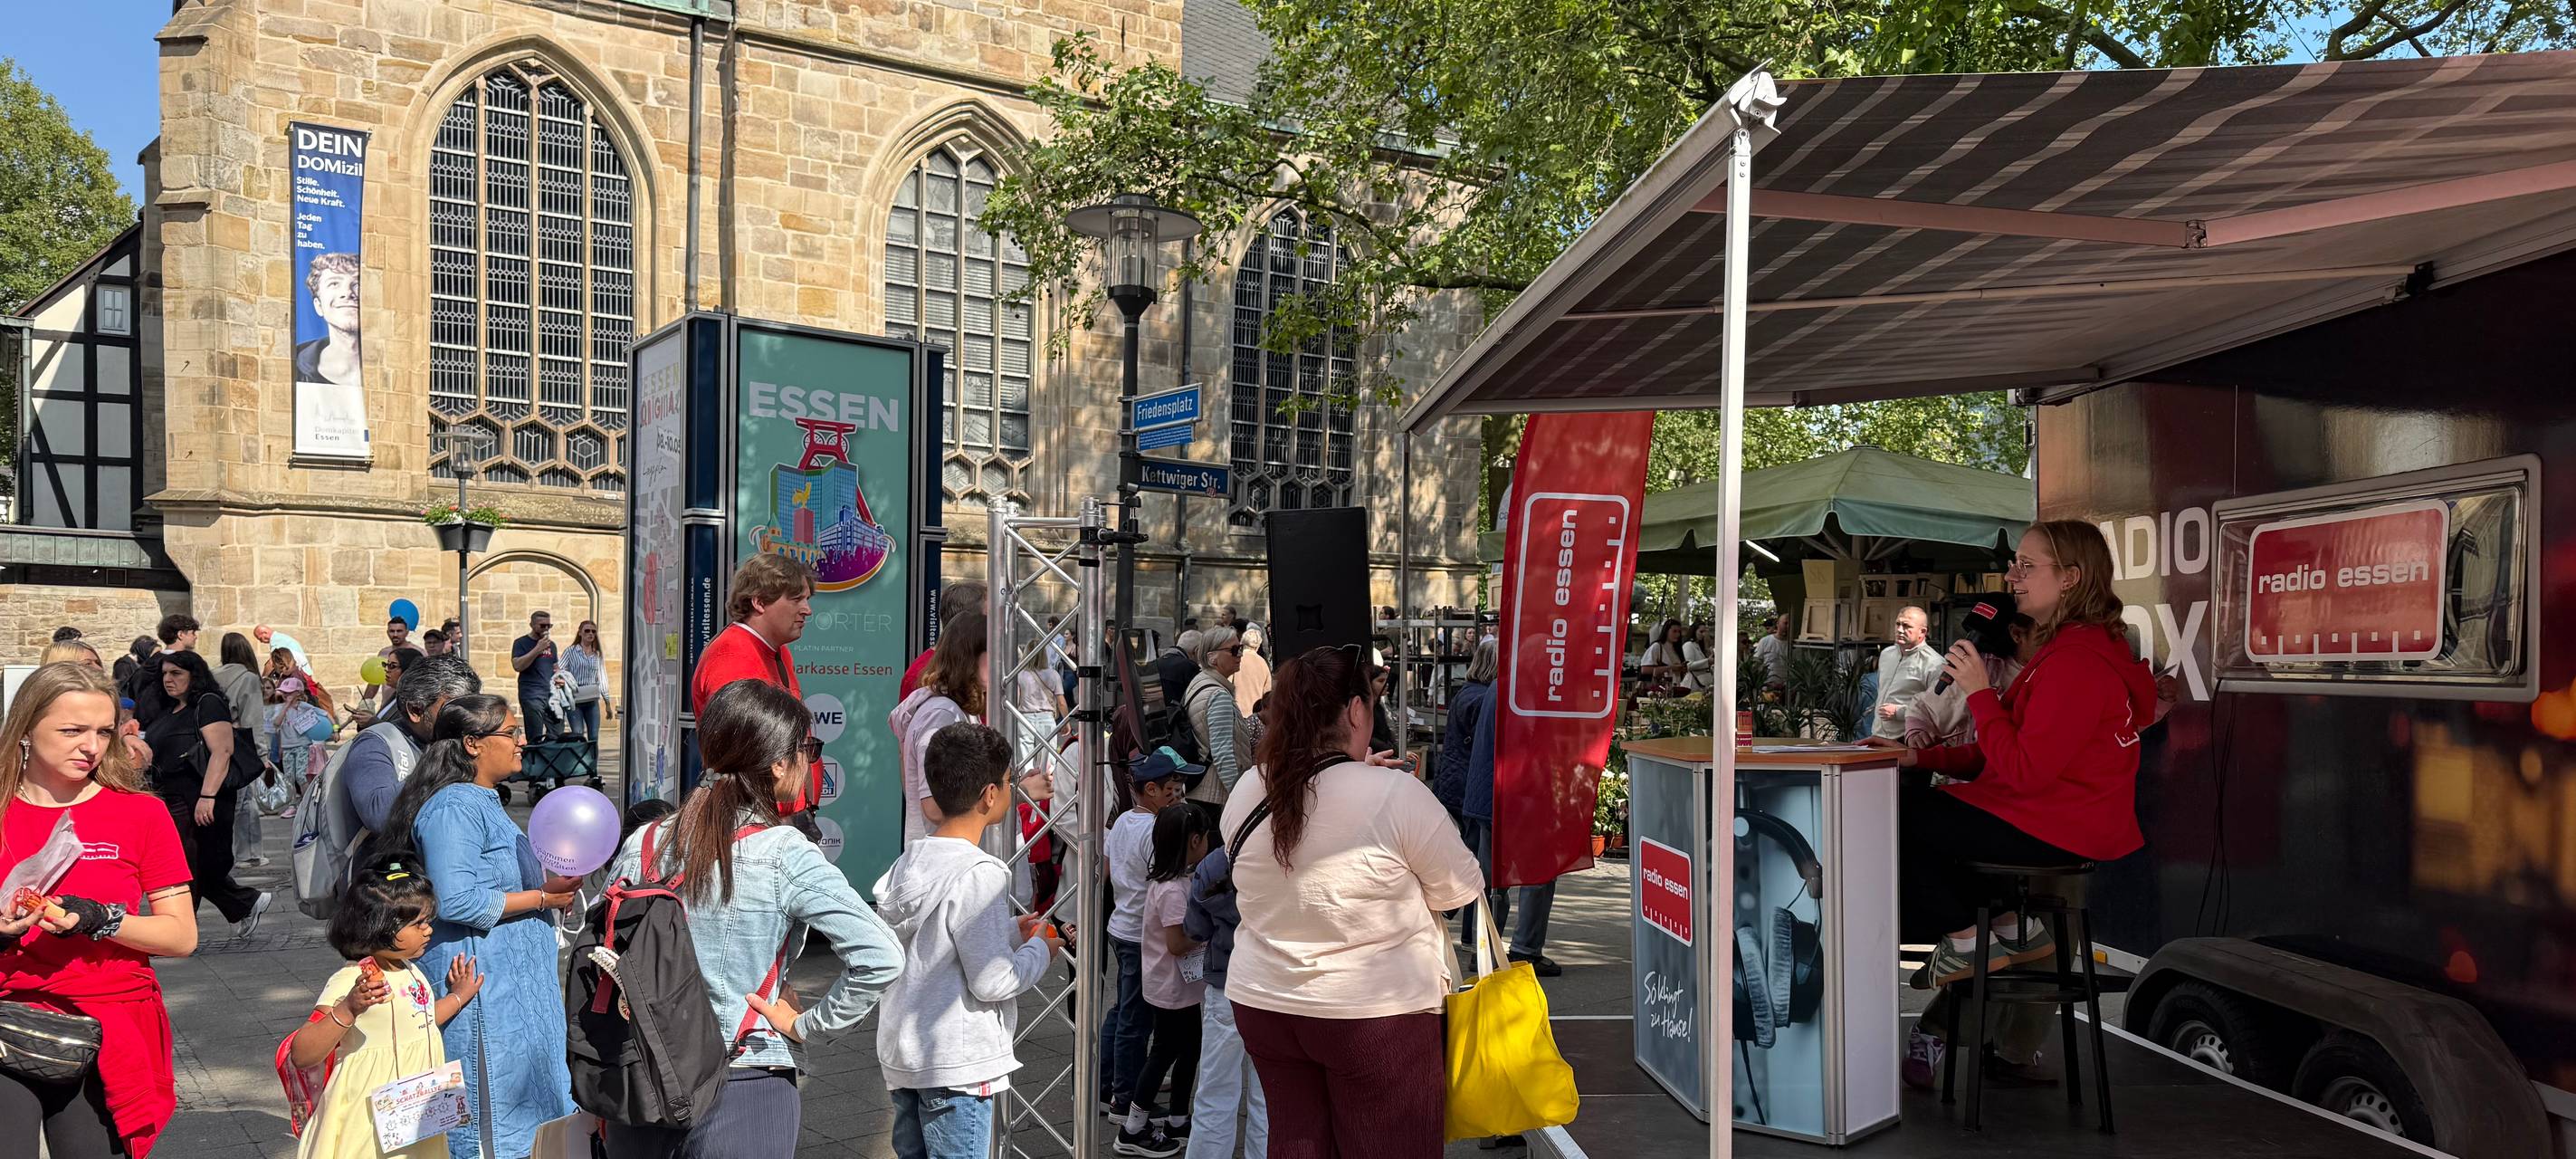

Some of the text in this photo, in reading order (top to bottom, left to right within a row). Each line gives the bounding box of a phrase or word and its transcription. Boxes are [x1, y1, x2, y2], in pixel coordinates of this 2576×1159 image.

[298, 129, 362, 158] DEIN
[298, 155, 362, 177] DOMizil
[297, 177, 320, 187] Stille.
[297, 186, 339, 198] Schönheit.
[297, 195, 346, 207] Neue Kraft.
[297, 213, 322, 222] Jeden
[298, 221, 313, 231] Tag
[297, 240, 325, 249] haben.
[749, 381, 899, 432] ESSEN
[1137, 397, 1193, 421] Friedensplatz
[1141, 465, 1221, 489] Kettwiger Str.
[2098, 506, 2209, 580] ADIO
[2258, 560, 2429, 594] radio essen
[1546, 509, 1578, 702] radio essen
[805, 611, 892, 632] PORTER
[821, 645, 854, 653] PARTNER
[2121, 600, 2210, 702] OX
[794, 662, 892, 675] arkasse Essen
[814, 712, 843, 724] WE
[398, 750, 408, 781] afari
[1643, 867, 1688, 900] radio essen
[1644, 971, 1684, 1020] So klingt
[1651, 1005, 1693, 1043] zu Hause!
